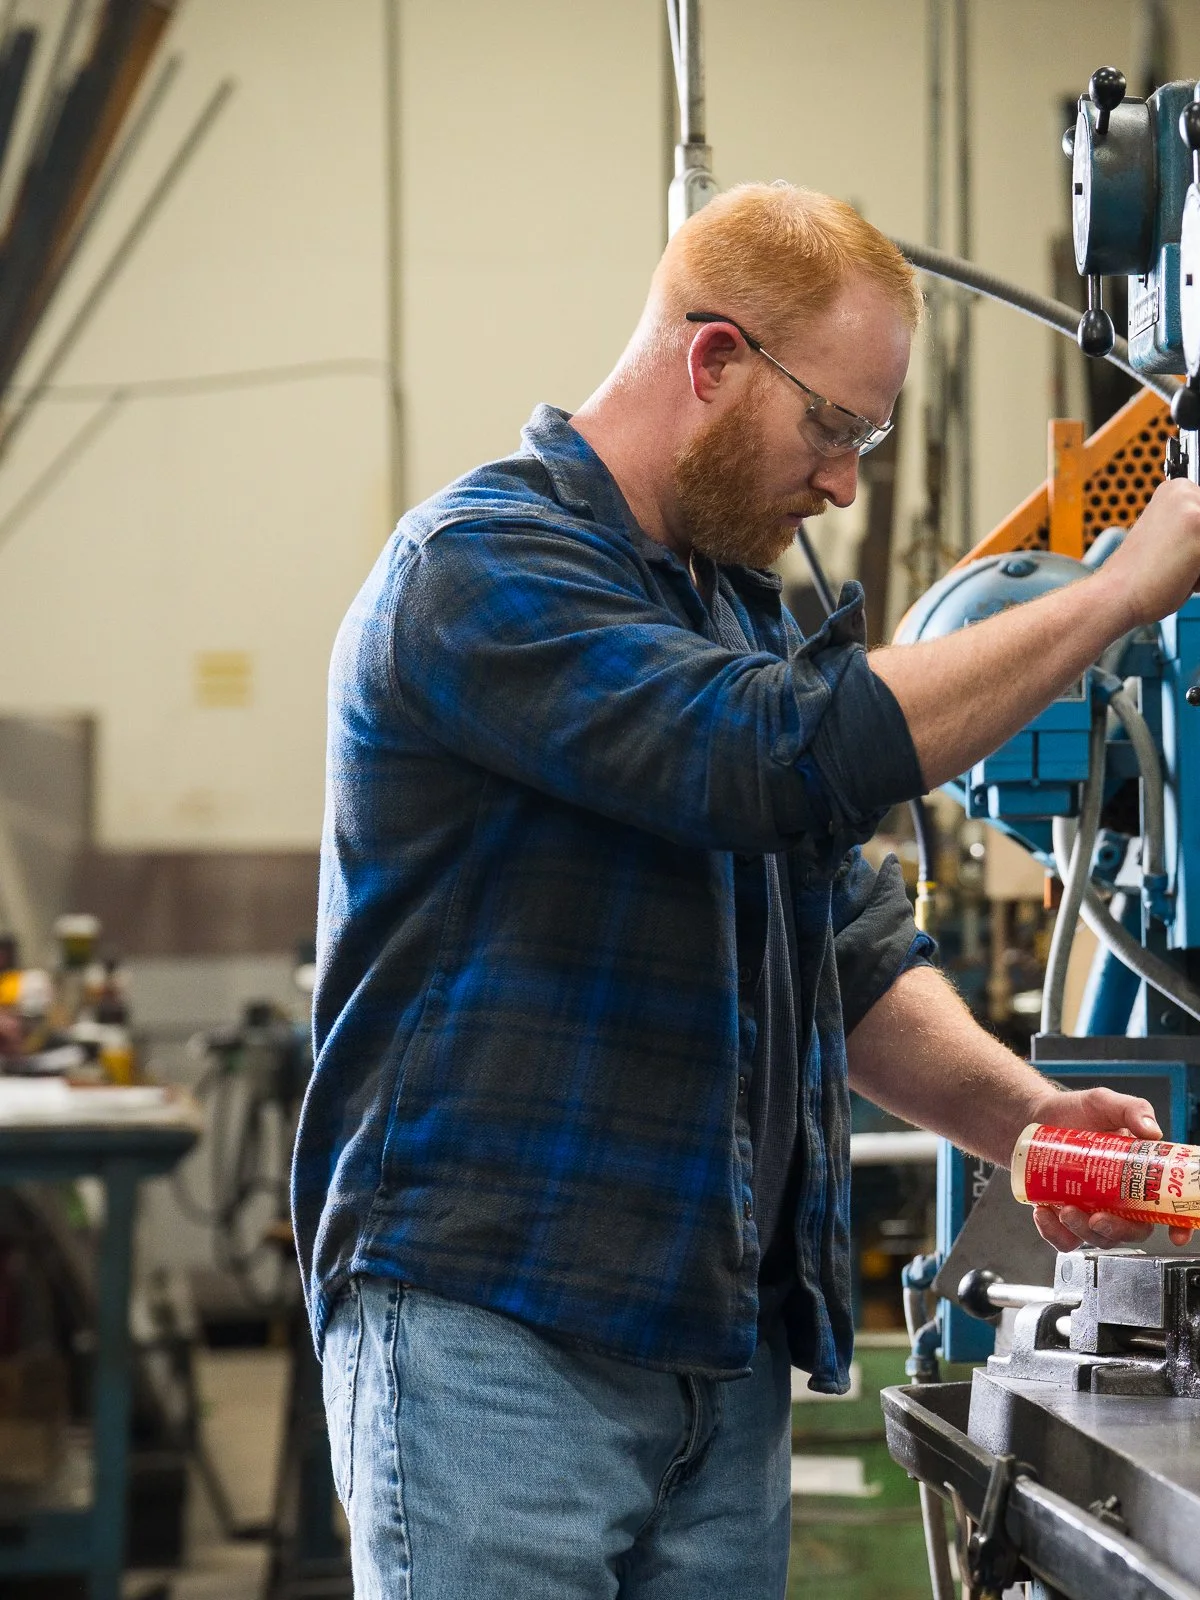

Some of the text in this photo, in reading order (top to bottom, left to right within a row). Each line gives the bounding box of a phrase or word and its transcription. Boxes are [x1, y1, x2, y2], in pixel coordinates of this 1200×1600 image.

[1132, 1142, 1152, 1171] Cutting
[1130, 1173, 1143, 1200] Fluid
[1168, 1147, 1193, 1197] MAGIC
